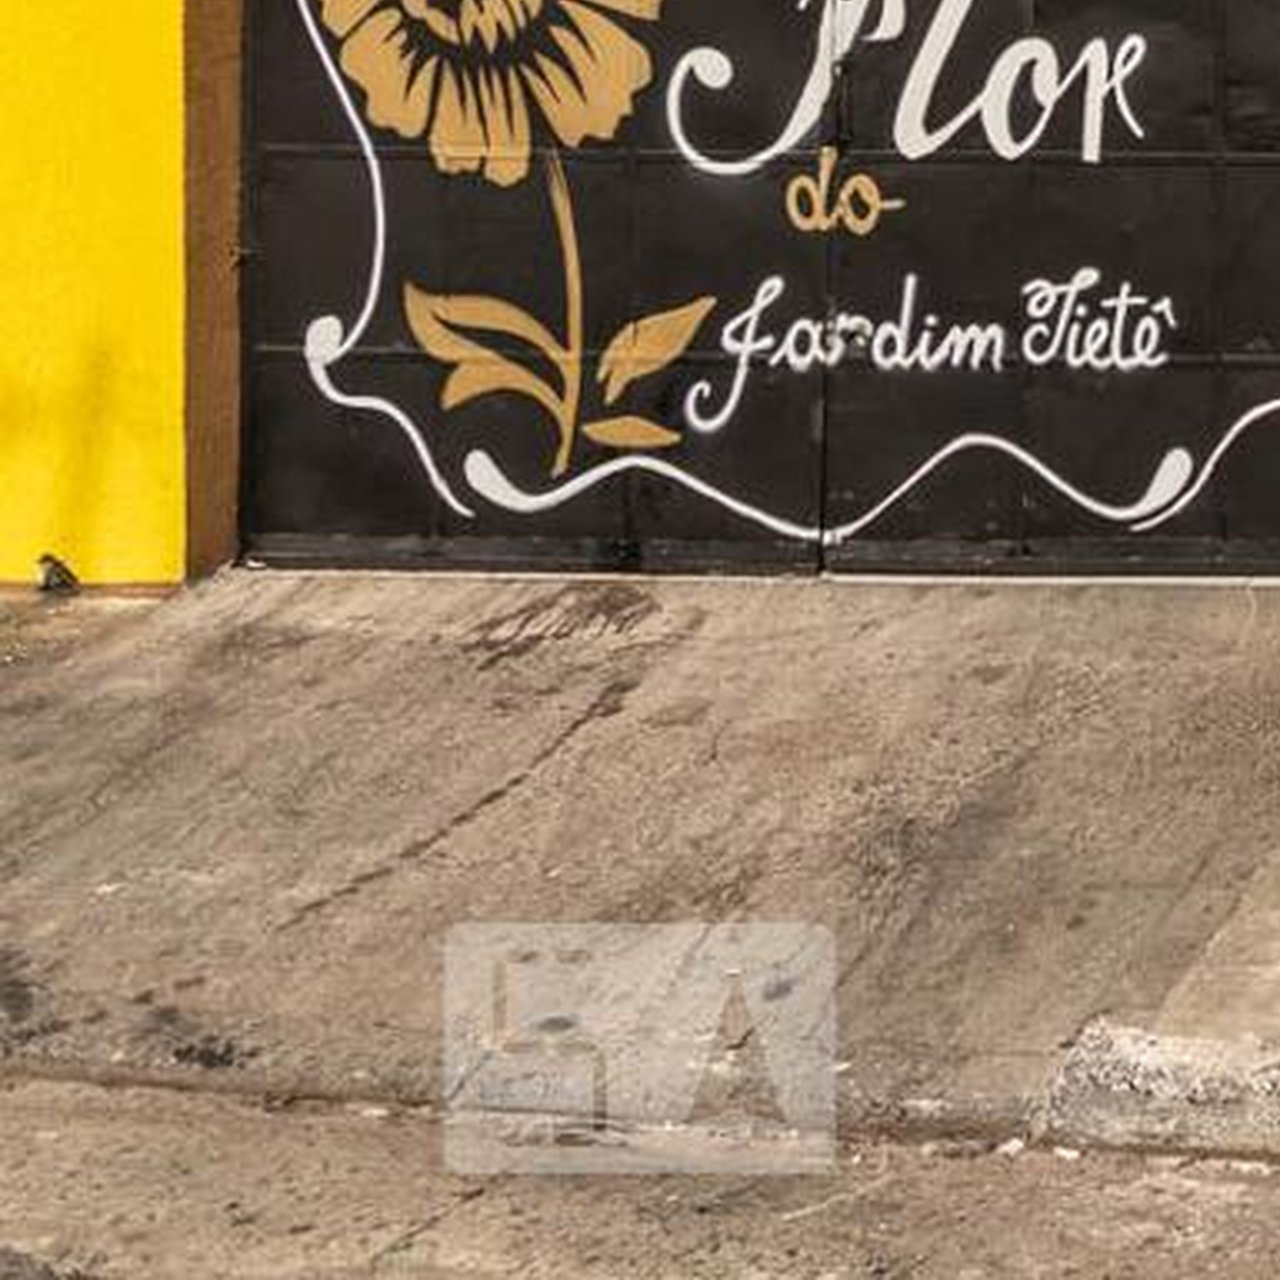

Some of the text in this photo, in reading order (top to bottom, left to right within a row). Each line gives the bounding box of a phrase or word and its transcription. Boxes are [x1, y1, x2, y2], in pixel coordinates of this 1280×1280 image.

[785, 145, 906, 236] do
[684, 266, 1179, 433] Jardim Tietê
